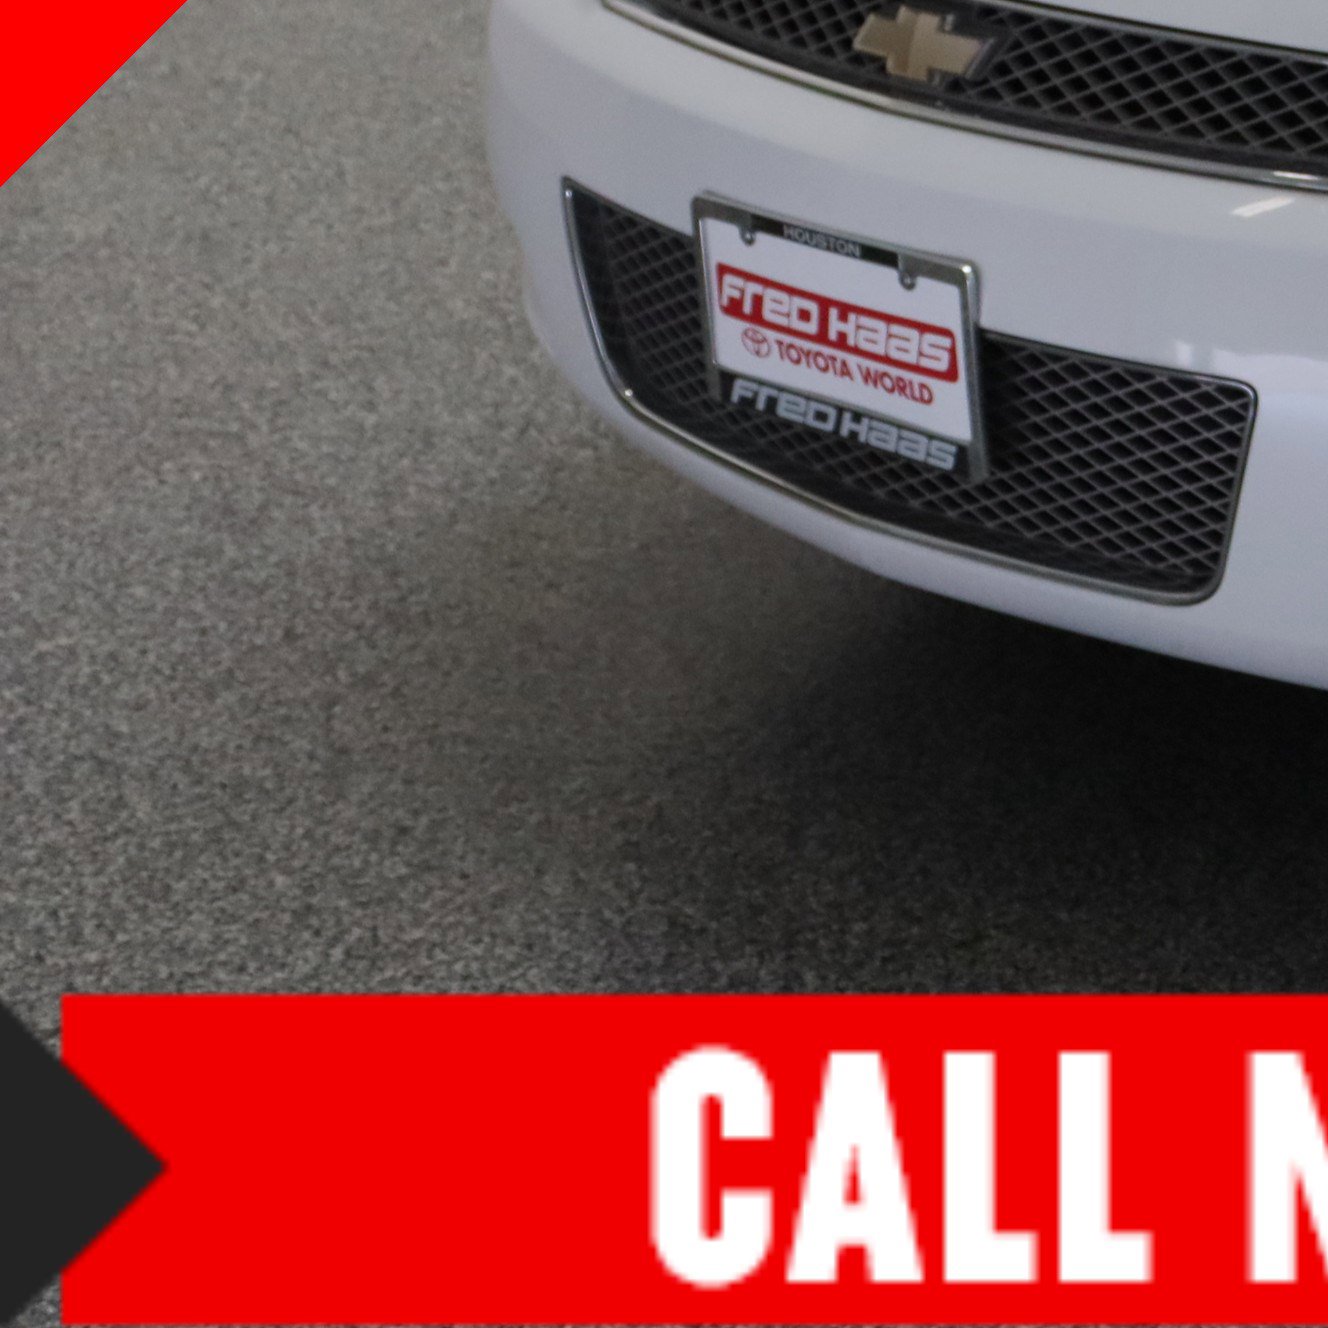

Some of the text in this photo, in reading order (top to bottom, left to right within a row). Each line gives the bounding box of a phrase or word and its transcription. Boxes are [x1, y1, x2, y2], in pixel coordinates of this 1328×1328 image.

[782, 223, 861, 258] HOUSTON
[776, 338, 935, 406] TOYOTA WORLD
